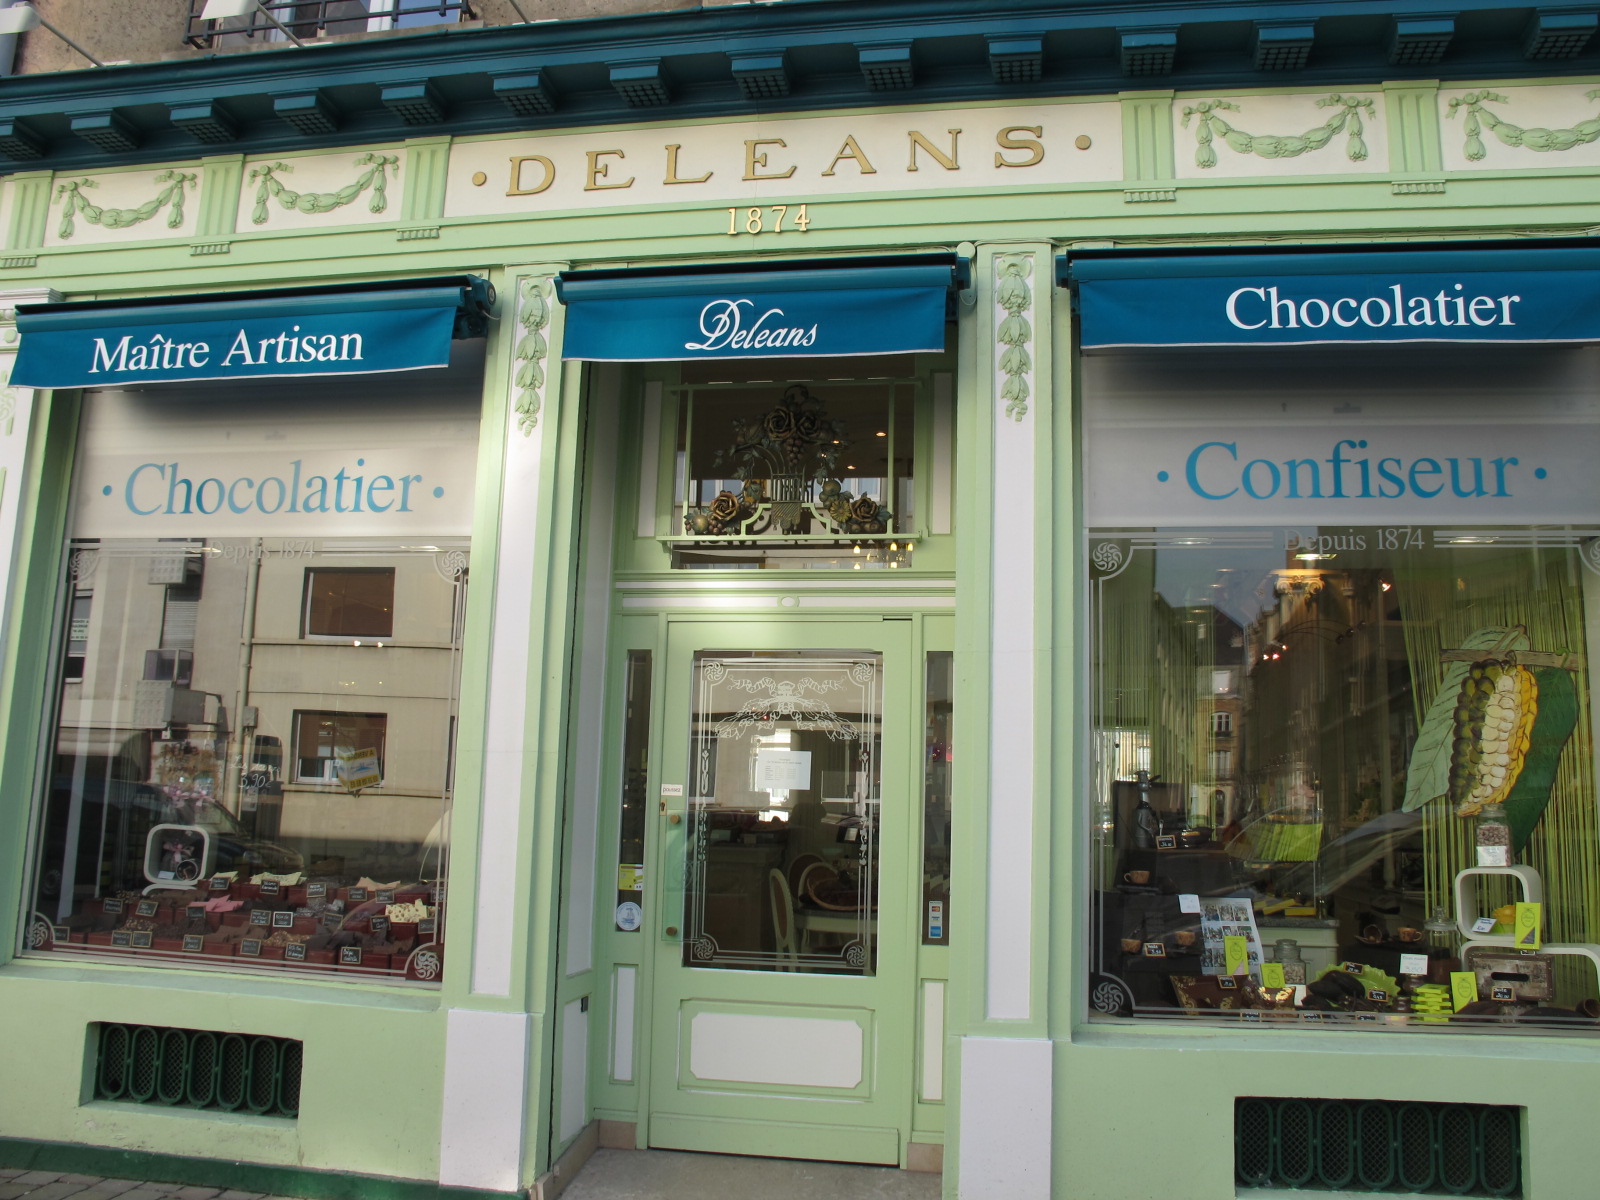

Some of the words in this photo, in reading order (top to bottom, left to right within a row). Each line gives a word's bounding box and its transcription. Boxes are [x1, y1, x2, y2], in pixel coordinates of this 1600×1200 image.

[505, 126, 1046, 197] DELEANS
[727, 204, 811, 236] 1874
[685, 299, 818, 351] Deleans
[1225, 283, 1521, 330] Chocolatier
[89, 332, 211, 373] Maître
[220, 325, 364, 367] Artisan
[125, 458, 422, 516] Chocolatier
[1184, 439, 1520, 501] Confiseur
[208, 540, 271, 564] Depuis
[278, 539, 316, 559] 1874
[1282, 528, 1367, 555] Depuis
[1376, 528, 1425, 551] 1874
